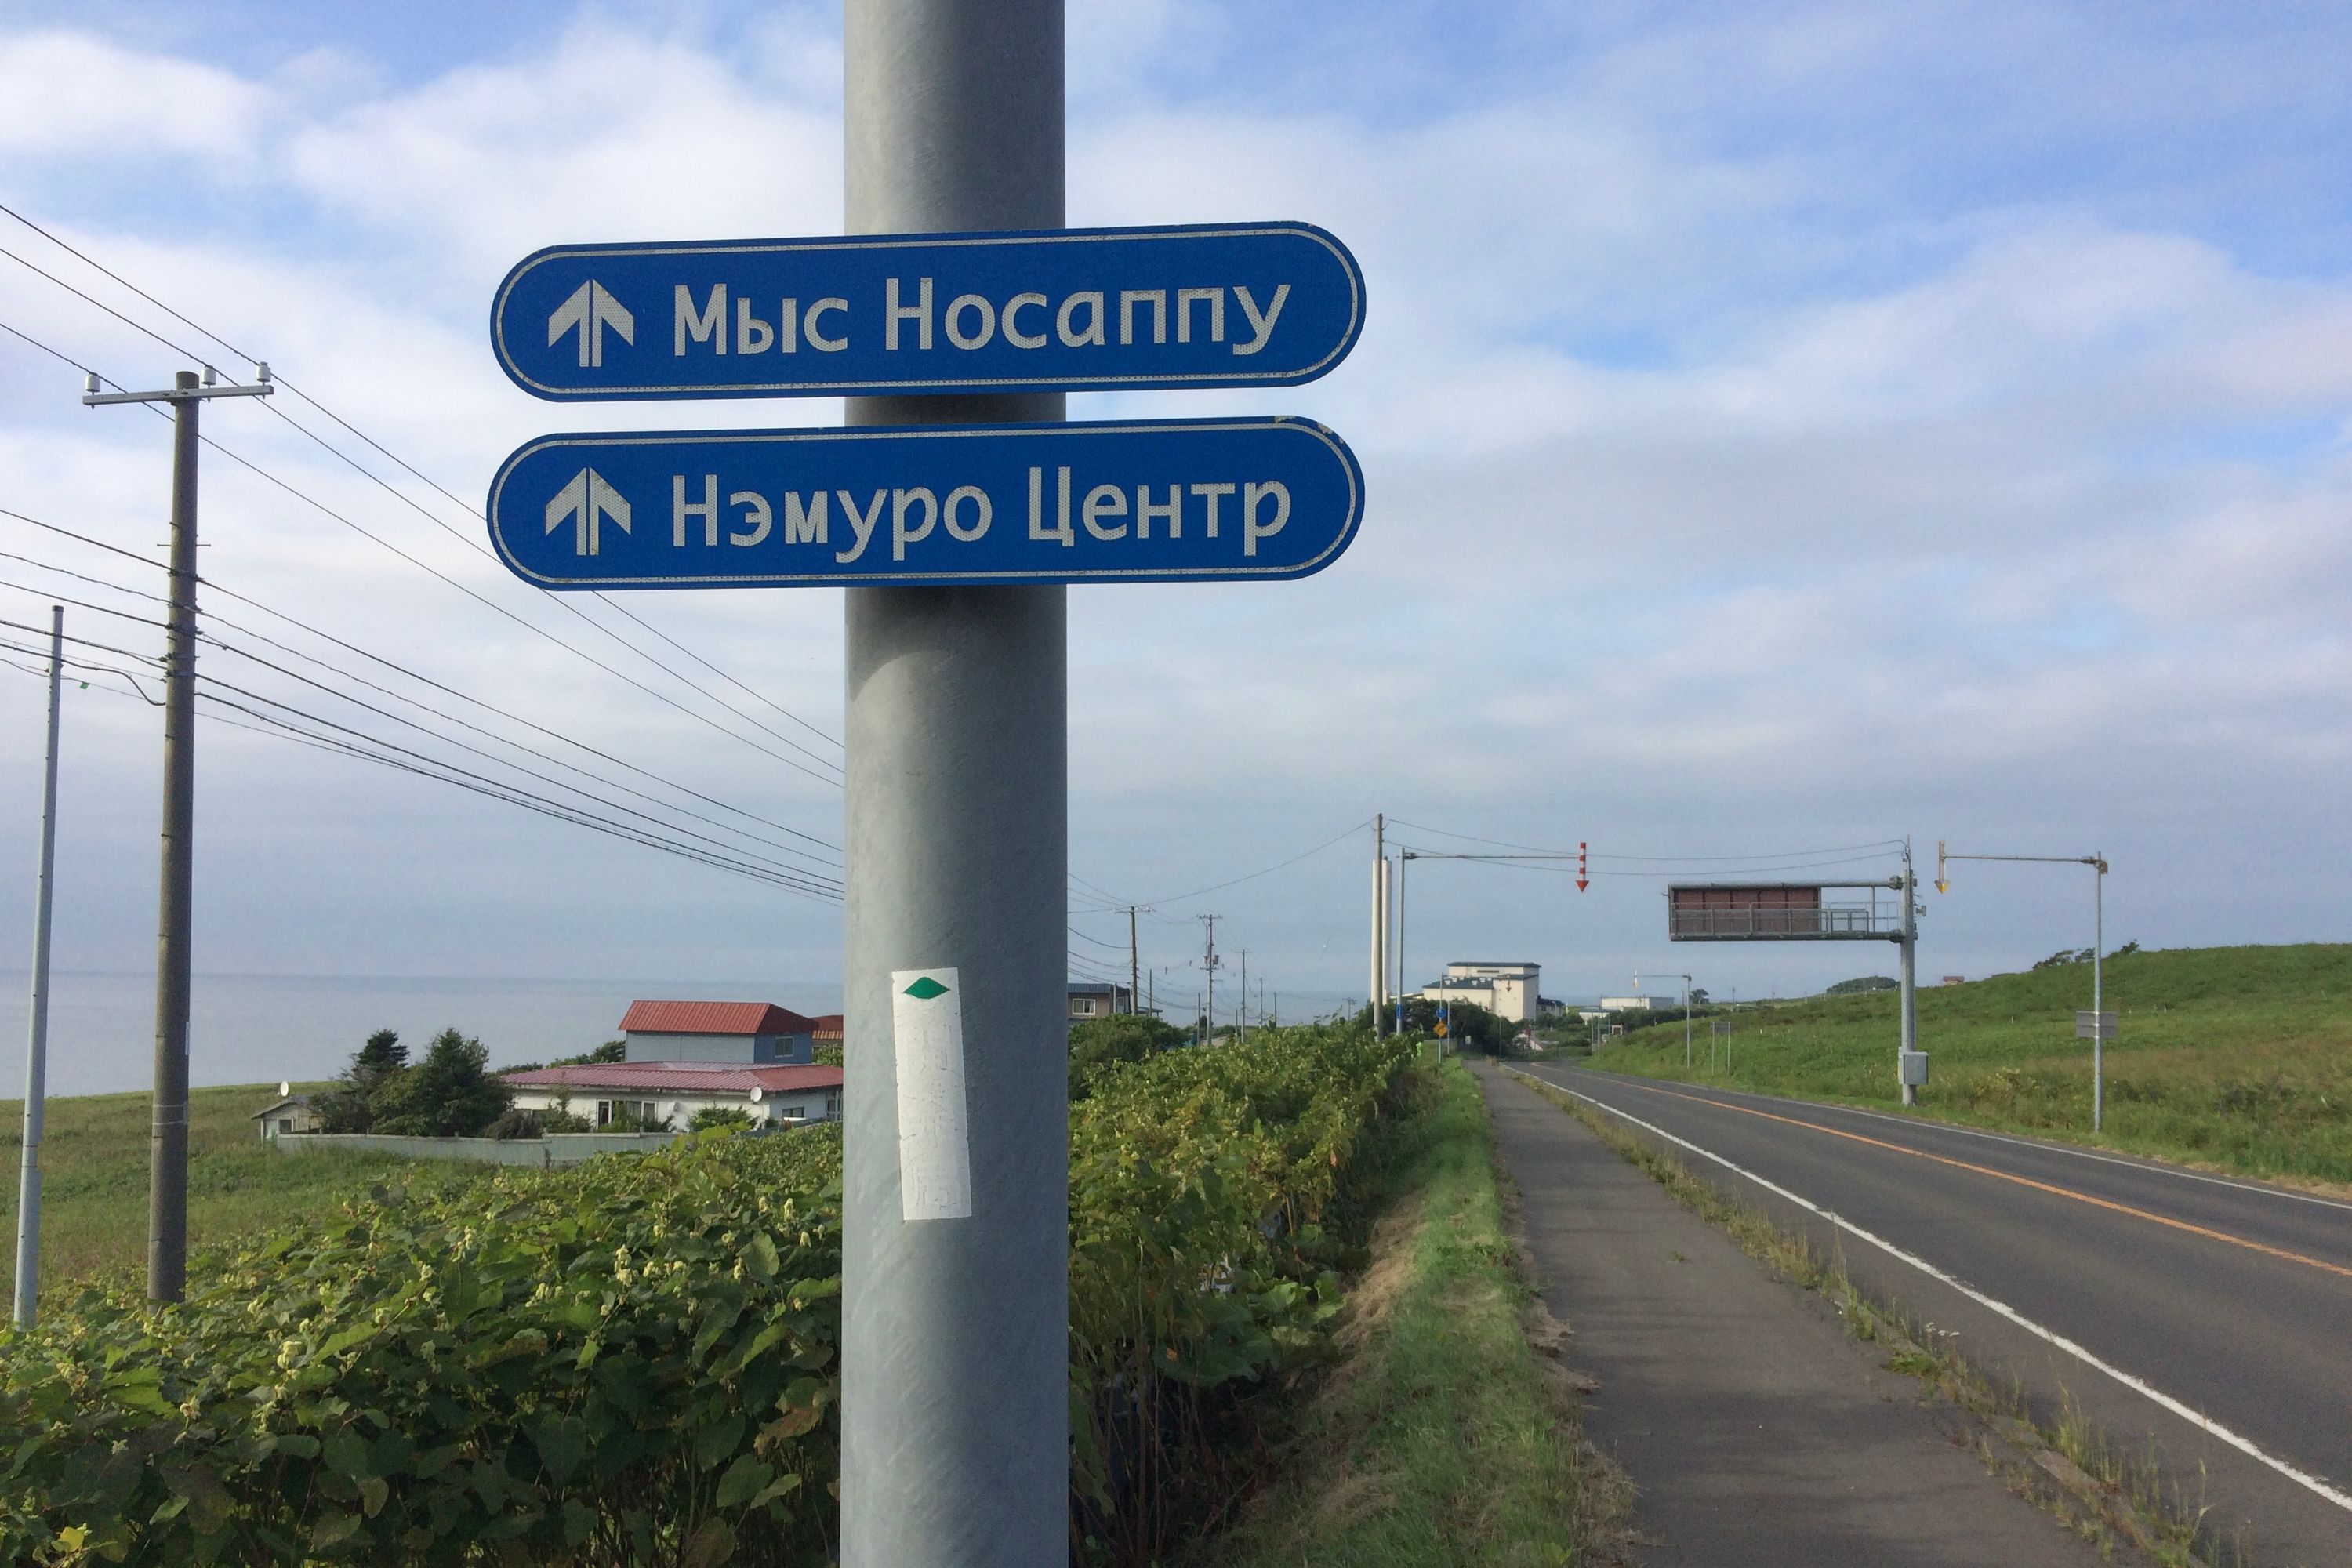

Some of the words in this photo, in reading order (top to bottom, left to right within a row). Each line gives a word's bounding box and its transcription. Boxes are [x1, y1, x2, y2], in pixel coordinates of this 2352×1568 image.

[674, 283, 848, 356] Мыс
[885, 278, 1291, 355] Носаппу
[673, 474, 993, 563] Нэмуро
[1029, 466, 1292, 556] Центр
